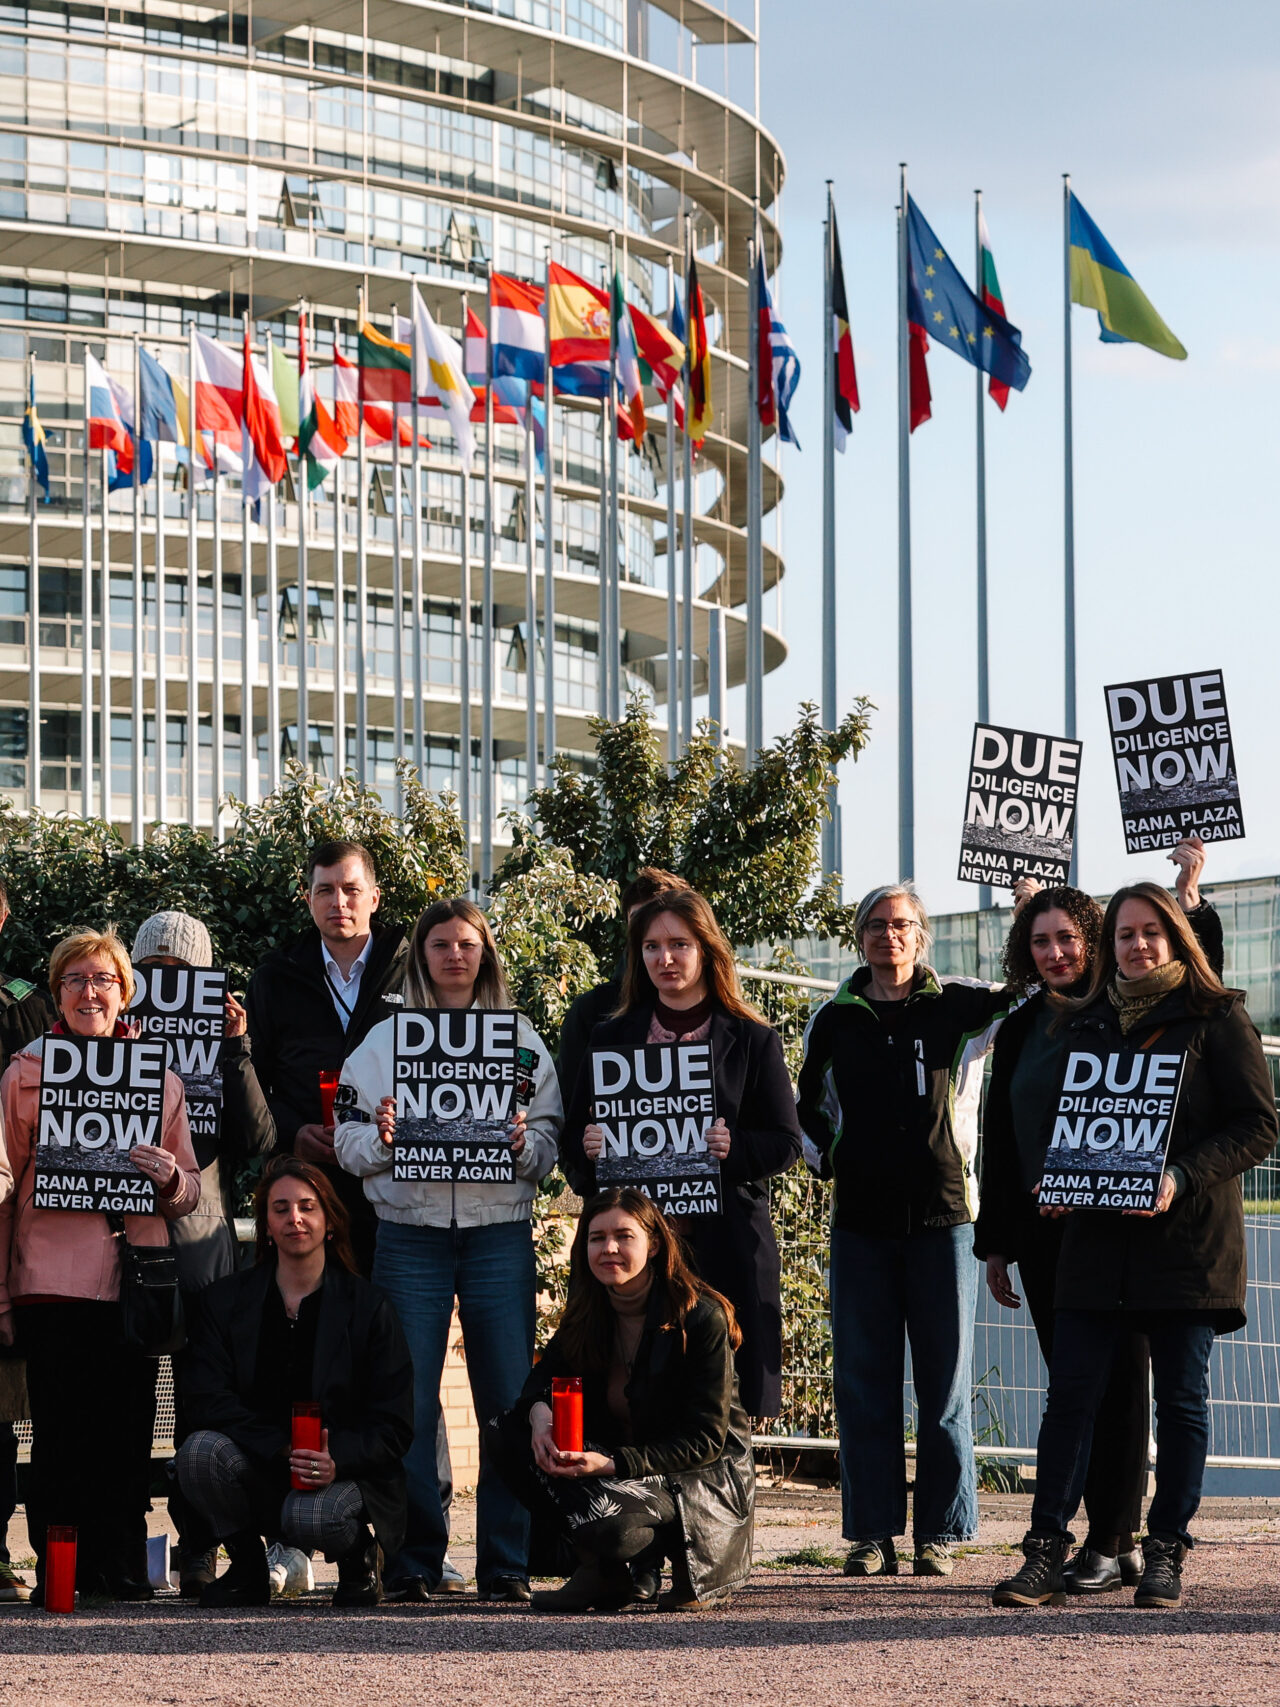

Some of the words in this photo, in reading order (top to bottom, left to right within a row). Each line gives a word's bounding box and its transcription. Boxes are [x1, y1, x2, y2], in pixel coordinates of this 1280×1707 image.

[1108, 674, 1224, 731] DUE
[1115, 722, 1228, 753] DILIGENCE
[973, 728, 1079, 784] DUE
[1117, 743, 1232, 792] NOW
[971, 772, 1075, 804] DILIGENCE
[966, 792, 1072, 840] NOW
[1125, 815, 1176, 834] RANA
[1181, 806, 1238, 826] PLAZA
[960, 866, 1012, 886] NEVER
[962, 850, 1008, 869] RANA
[1013, 858, 1065, 879] PLAZA
[398, 1013, 514, 1057] DUE
[44, 1039, 162, 1088] DUE
[397, 1062, 514, 1080] DILIGENCE
[593, 1046, 710, 1095] DUE
[1063, 1052, 1180, 1094] DUE
[42, 1088, 160, 1110] DILIGENCE
[186, 1103, 216, 1118] AZA
[395, 1083, 513, 1120] NOW
[596, 1095, 712, 1118] DILIGENCE
[1059, 1097, 1172, 1114] DILIGENCE
[40, 1110, 158, 1152] NOW
[190, 1120, 216, 1134] AIN
[599, 1116, 712, 1158] NOW
[1051, 1117, 1168, 1152] NOW
[395, 1148, 446, 1161] RANA
[454, 1148, 512, 1162] PLAZA
[37, 1175, 88, 1190] RANA
[95, 1178, 153, 1194] PLAZA
[395, 1166, 452, 1179] NEVER
[458, 1167, 512, 1180] AGAIN
[1042, 1175, 1090, 1188] RANA
[1097, 1177, 1153, 1191] PLAZA
[36, 1193, 93, 1208] NEVER
[99, 1197, 153, 1212] AGAIN
[658, 1181, 716, 1197] PLAZA
[1039, 1191, 1094, 1204] NEVER
[1098, 1194, 1152, 1207] AGAIN
[664, 1199, 717, 1214] AGAIN
